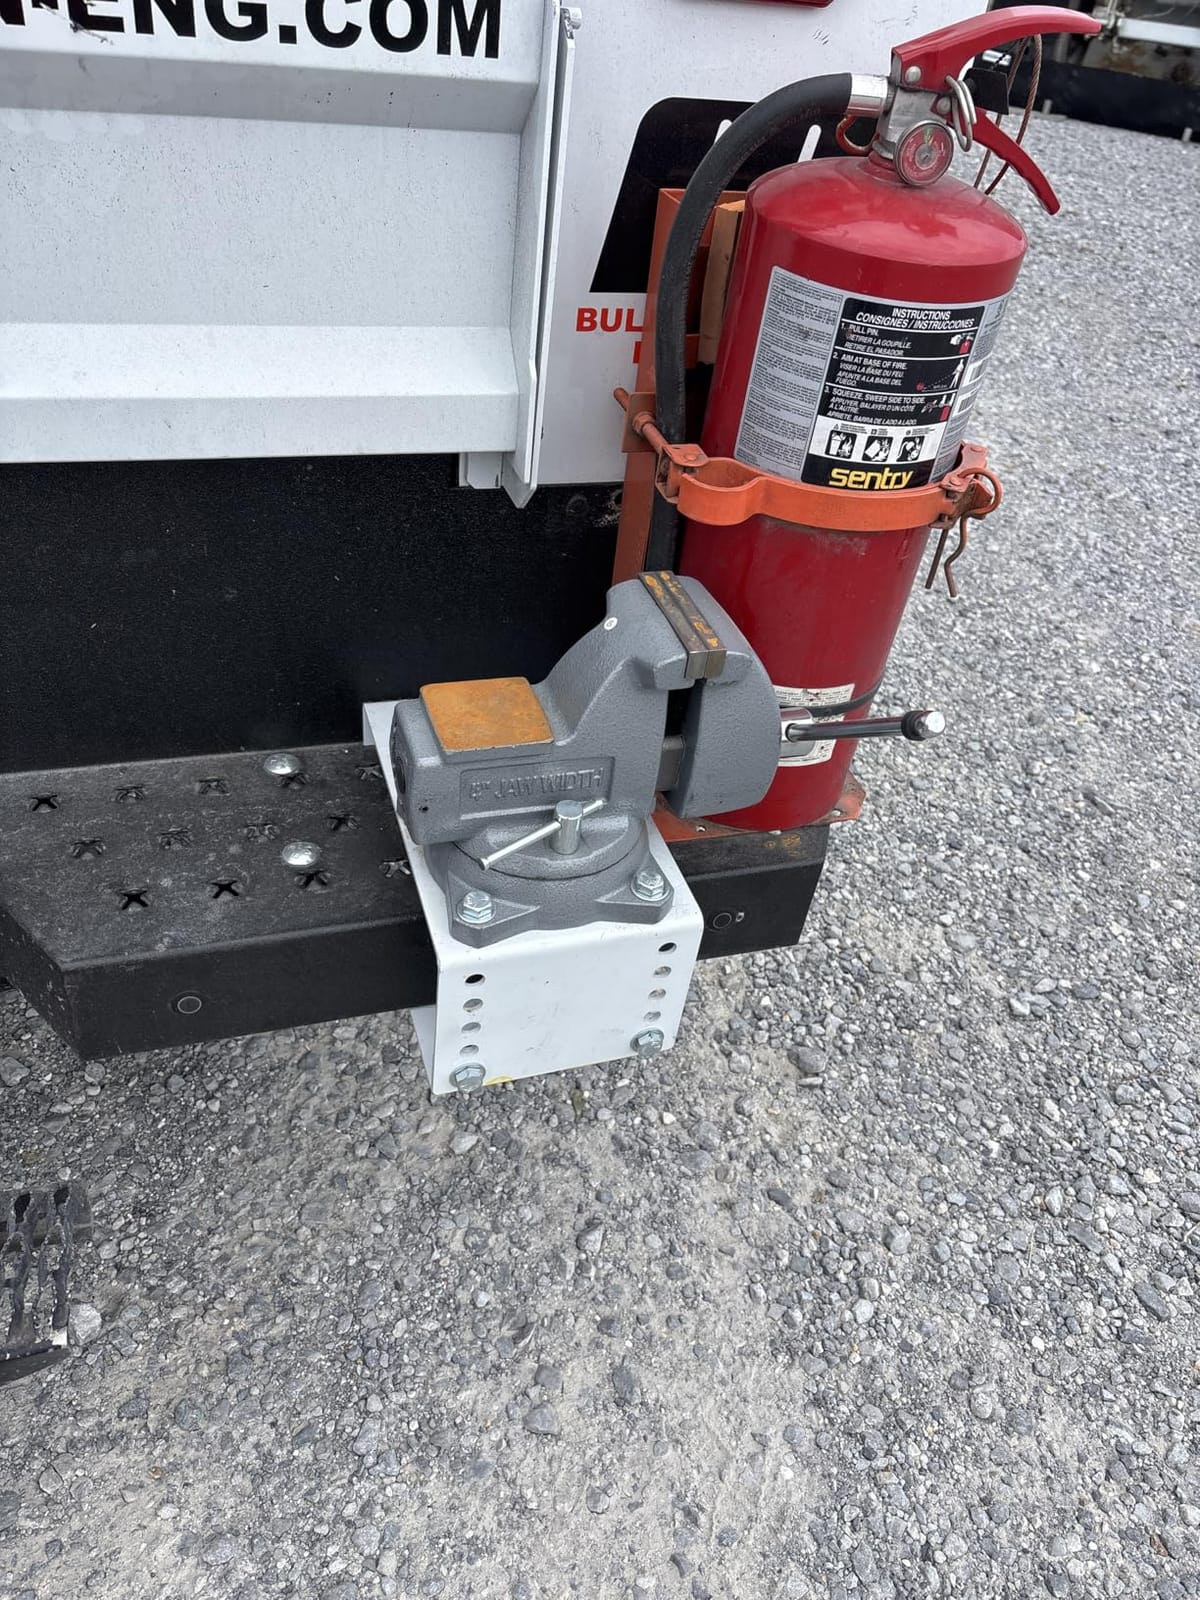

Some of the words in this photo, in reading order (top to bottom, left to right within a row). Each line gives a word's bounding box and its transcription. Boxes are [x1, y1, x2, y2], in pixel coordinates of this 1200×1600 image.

[892, 307, 951, 320] INSTRUCTIONS
[855, 311, 909, 328] CONSIGNES
[913, 318, 975, 330] INSTRUCCIONES
[844, 341, 867, 351] RETIRE
[873, 338, 881, 346] LA
[841, 353, 854, 362] AIM
[863, 358, 882, 367] BASE
[840, 362, 858, 371] VISER
[837, 370, 861, 381] APUNTE
[873, 377, 891, 385] BASE
[864, 393, 888, 403] SWEEP
[887, 396, 903, 404] SIDE
[859, 401, 887, 411] BALAYER
[852, 414, 874, 424] BARRA
[828, 466, 914, 490] sentry
[494, 776, 535, 799] JAW
[538, 768, 604, 794] WIDTH
